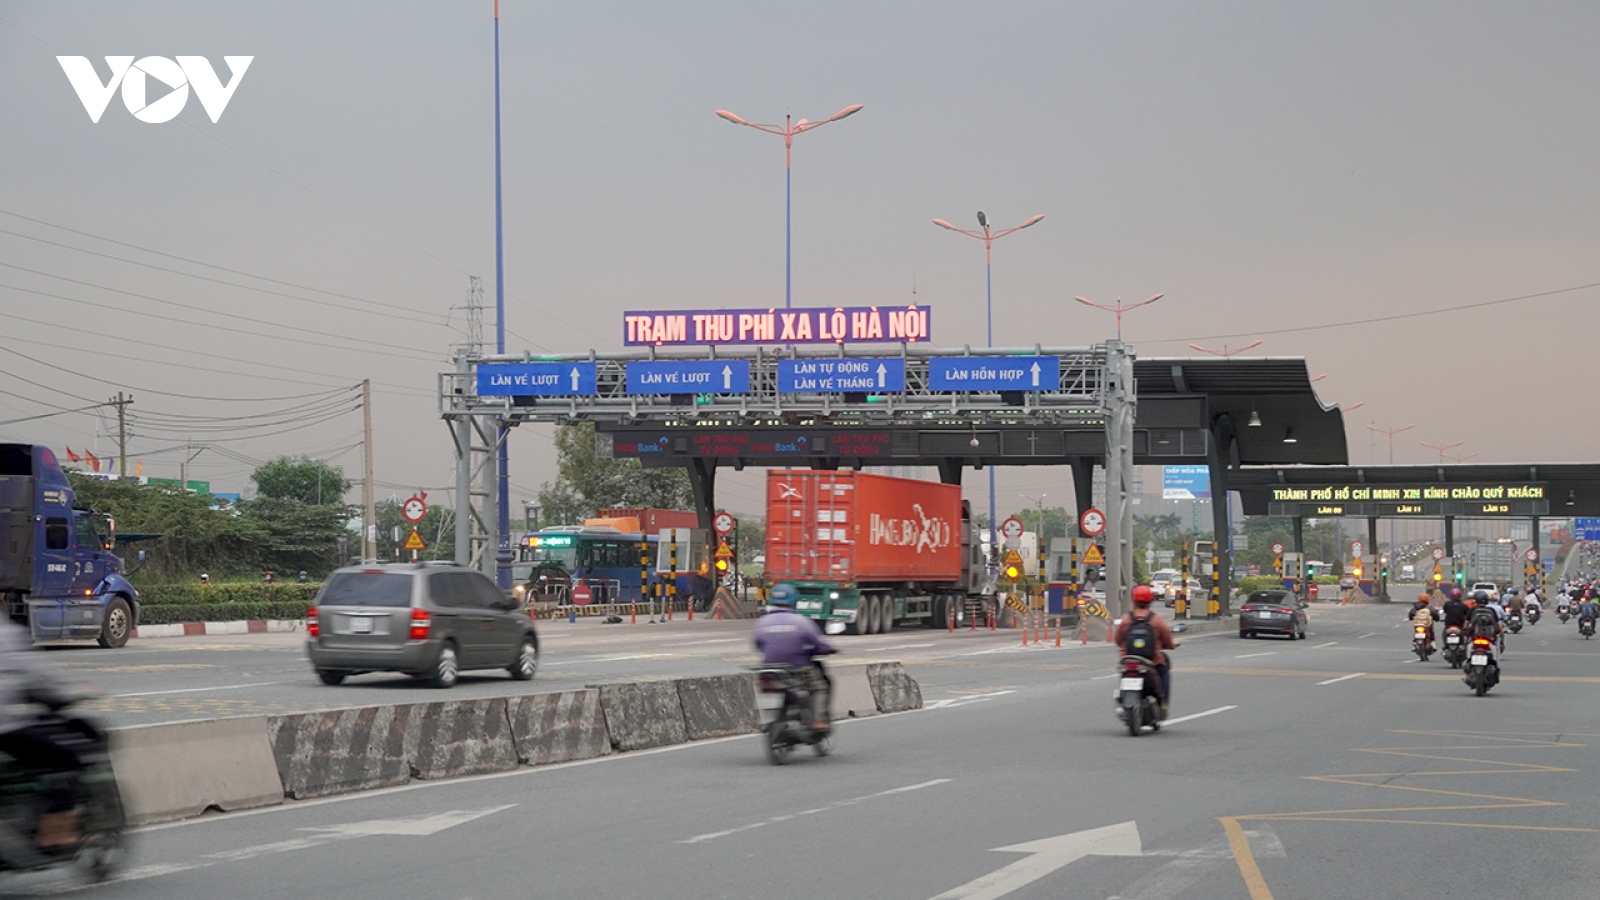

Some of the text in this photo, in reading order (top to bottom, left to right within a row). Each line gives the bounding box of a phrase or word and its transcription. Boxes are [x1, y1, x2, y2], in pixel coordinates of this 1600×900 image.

[625, 304, 927, 346] TRẠM THU PHÍ XA LỘ HÀ NỘI
[794, 360, 869, 375] LÀN TỰ ĐỘNG
[945, 366, 1025, 382] LÀN HỖN HỢP
[491, 370, 560, 387] LÀN VÉ LƯỢT
[640, 369, 711, 386] LÀN VÉ LƯỢT
[794, 375, 874, 390] LÀN VÉ THÁNG
[1273, 487, 1308, 500] THÀNH
[1310, 485, 1333, 500] PHỐ
[1352, 487, 1371, 500] CHÍ
[1373, 488, 1400, 500] MINH
[1403, 488, 1421, 499] XIN
[1424, 486, 1449, 499] KÍNH
[1452, 485, 1480, 499] CHÀO
[1483, 485, 1504, 498] QUÝ
[1507, 485, 1543, 498] KHÁCH
